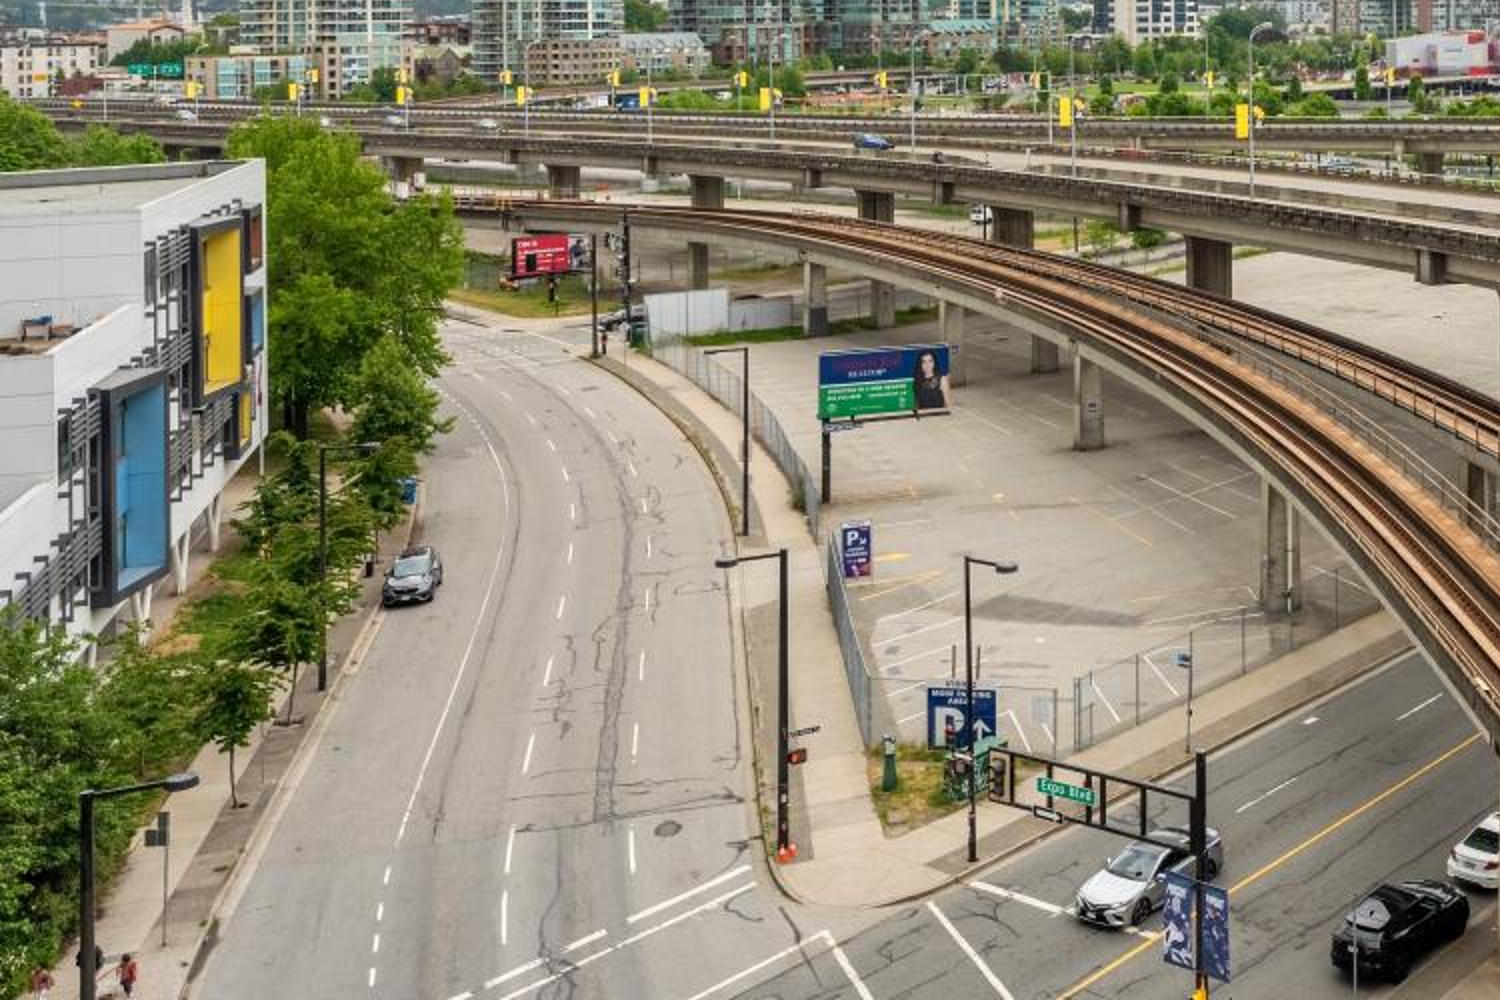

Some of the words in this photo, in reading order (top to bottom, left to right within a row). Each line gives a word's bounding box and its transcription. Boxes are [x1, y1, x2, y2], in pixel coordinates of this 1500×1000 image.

[847, 531, 859, 547] P
[1041, 779, 1065, 795] Expo
[1069, 786, 1091, 801] Blvd
